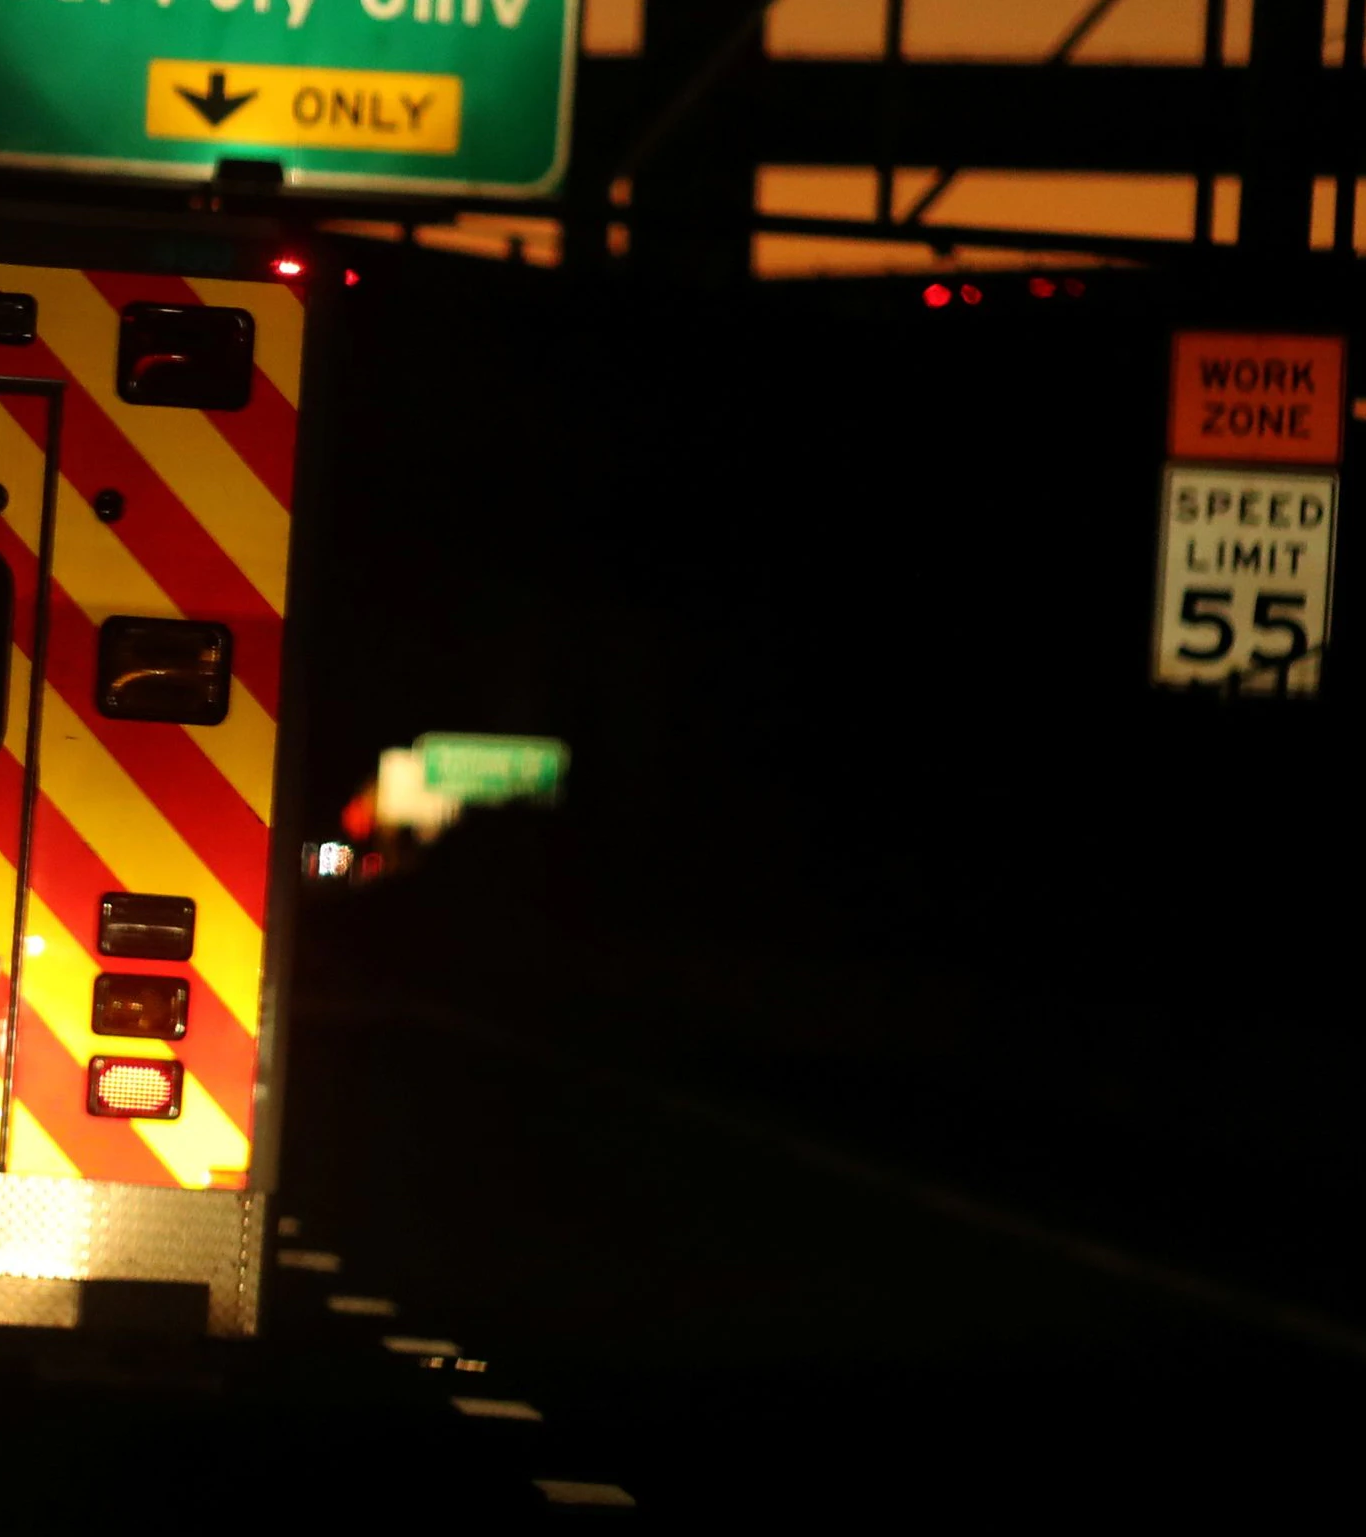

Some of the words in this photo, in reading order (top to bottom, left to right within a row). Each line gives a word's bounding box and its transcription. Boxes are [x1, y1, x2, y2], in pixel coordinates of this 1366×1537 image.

[292, 85, 435, 136] ONLY
[1199, 356, 1315, 395] WORK
[1200, 401, 1313, 440] ZONE
[1176, 487, 1324, 530] SPEED
[1186, 540, 1308, 578] LIMIT
[1176, 586, 1309, 667] 55
